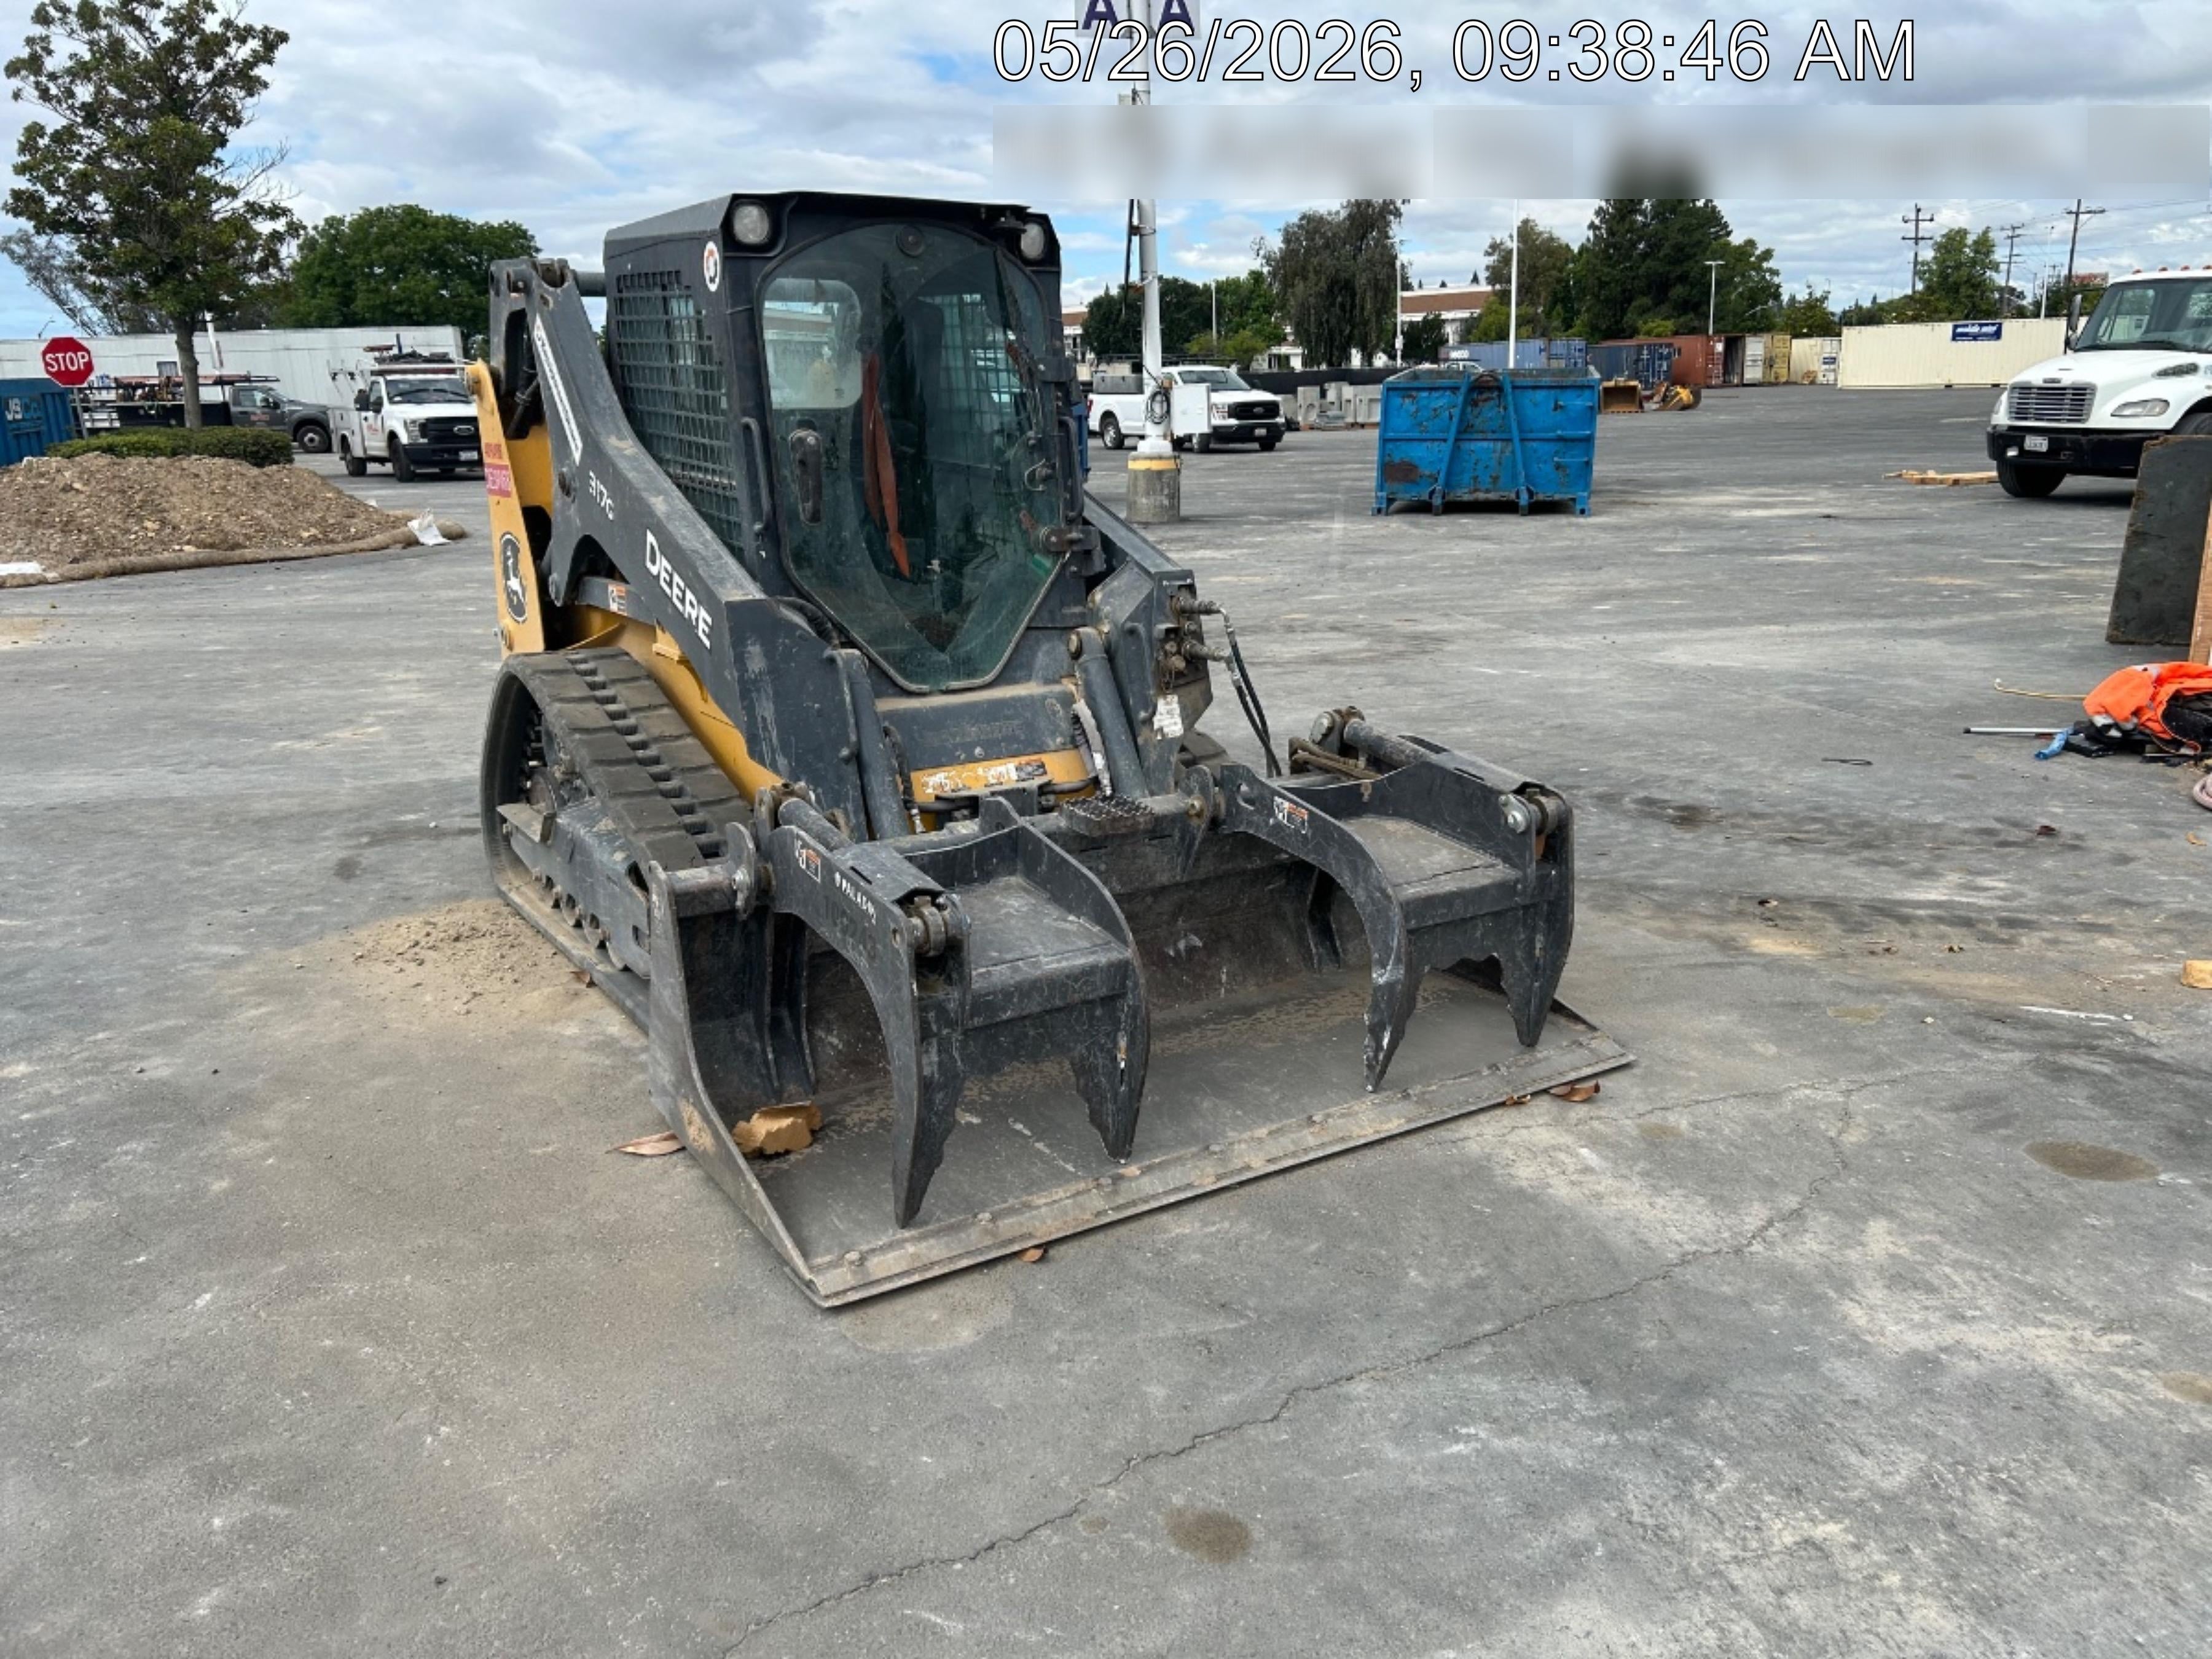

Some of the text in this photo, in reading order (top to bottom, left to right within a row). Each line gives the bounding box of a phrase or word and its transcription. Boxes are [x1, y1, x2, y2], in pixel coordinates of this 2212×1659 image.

[1082, 0, 1120, 29] A
[45, 351, 89, 372] STOP
[645, 528, 713, 649] DEERE
